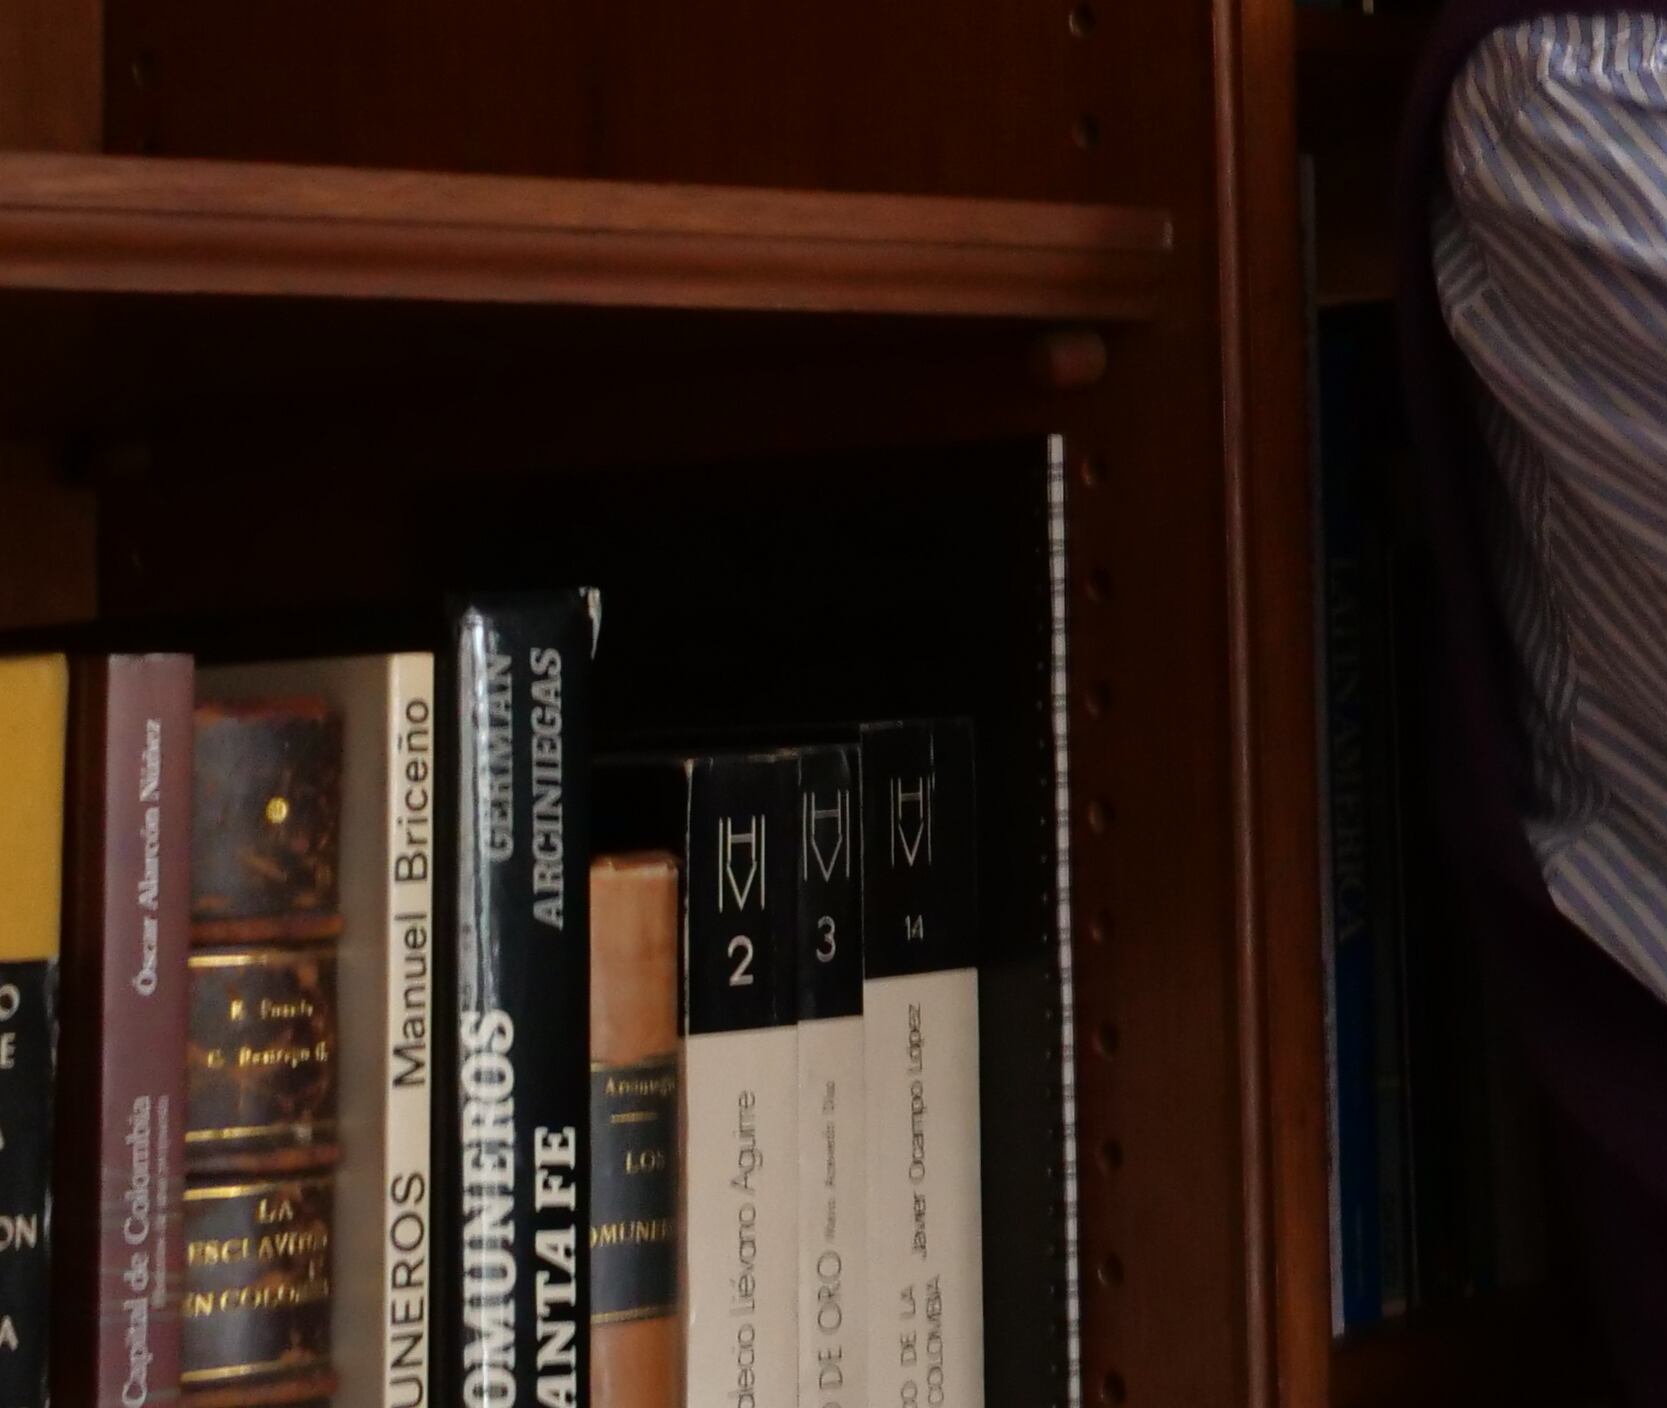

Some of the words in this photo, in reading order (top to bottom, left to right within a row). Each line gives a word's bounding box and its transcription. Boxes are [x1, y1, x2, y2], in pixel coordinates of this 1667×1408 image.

[1329, 558, 1362, 709] LATIN
[395, 697, 431, 884] Briceño
[530, 647, 565, 931] ARCINIEGAS
[1331, 717, 1368, 946] AMERICA
[727, 935, 754, 987] 2
[815, 914, 836, 964] 3
[904, 914, 924, 942] 14
[391, 912, 429, 1090] Manuel
[904, 1002, 925, 1075] López
[123, 1095, 150, 1245] Colombia
[533, 1126, 577, 1213] FE
[730, 1090, 762, 1196] Aguirre
[907, 1080, 928, 1184] Ocampo
[258, 1198, 294, 1224] LA
[911, 1192, 928, 1259] Javier
[123, 1252, 149, 1292] de
[729, 1203, 757, 1317] Liévano
[815, 1251, 843, 1336] ORO
[899, 1285, 917, 1320] LA
[121, 1298, 153, 1408] Capital
[817, 1345, 844, 1390] DE
[899, 1331, 917, 1367] DE
[925, 1274, 946, 1404] COLOMBIA
